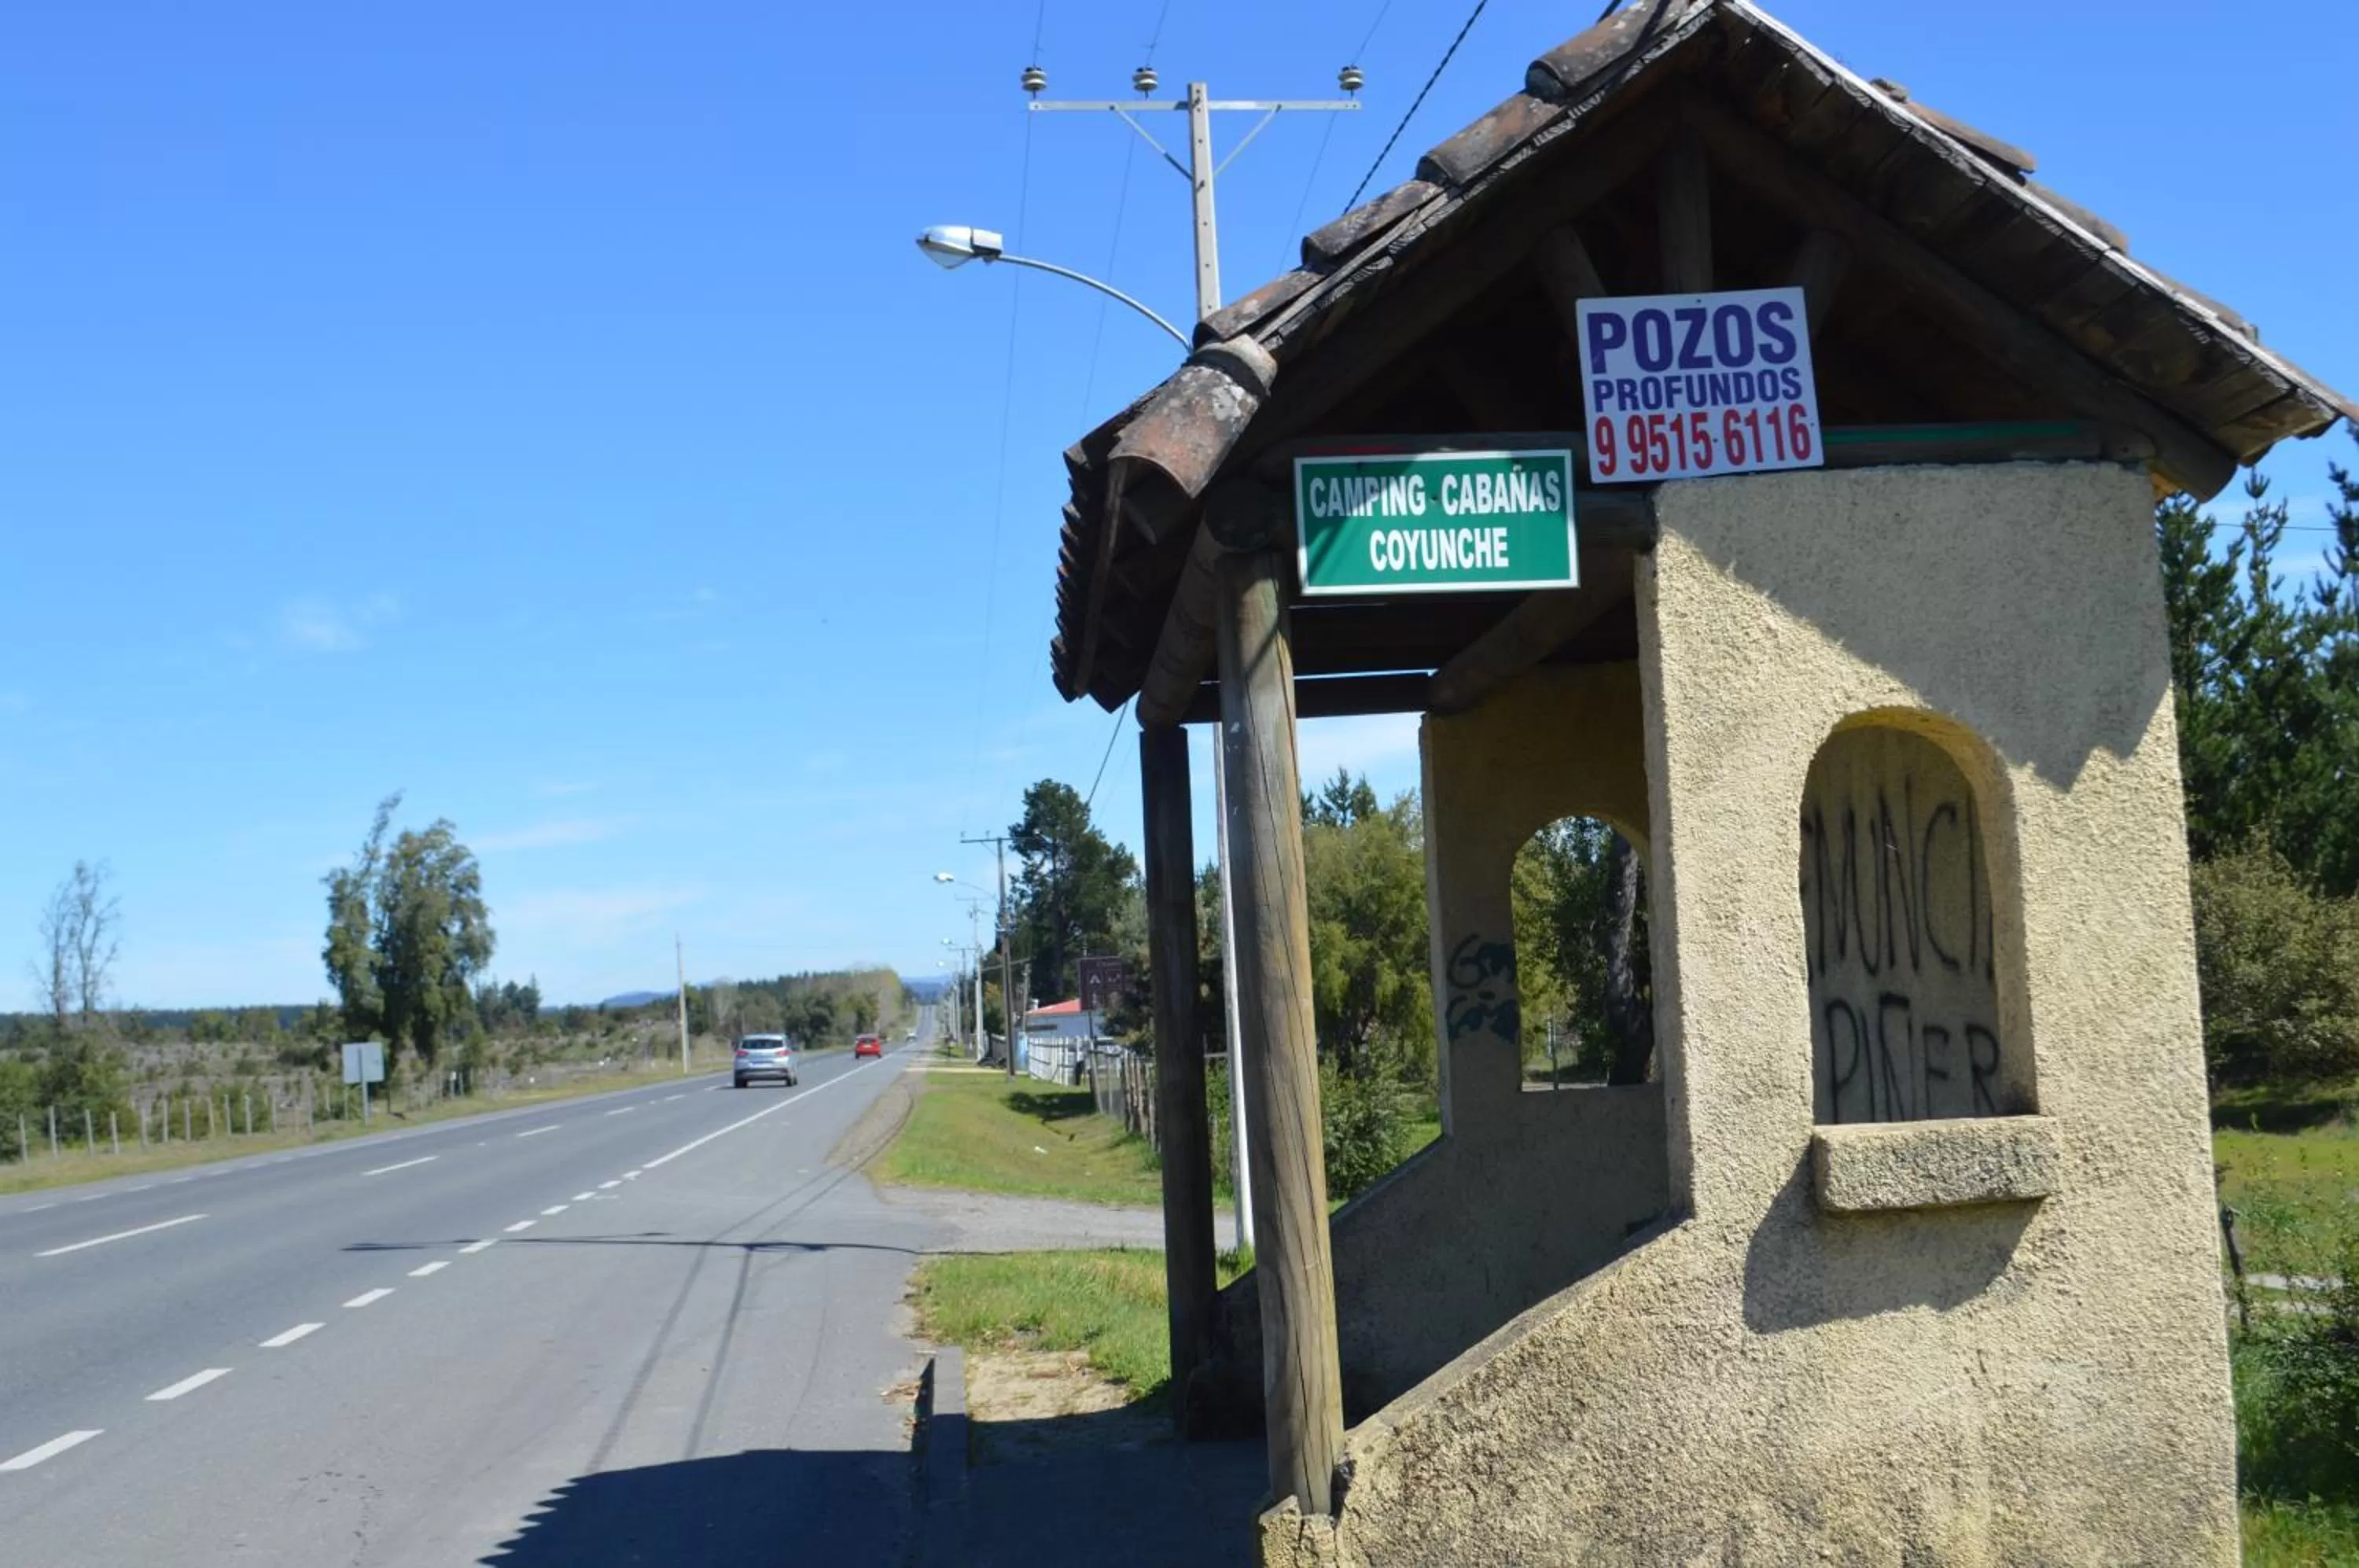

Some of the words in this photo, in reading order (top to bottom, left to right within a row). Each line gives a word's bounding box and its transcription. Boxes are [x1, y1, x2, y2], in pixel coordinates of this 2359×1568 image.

[1586, 301, 1798, 374] POZOS
[1592, 366, 1802, 413] PROFUNDOS
[1595, 415, 1617, 476] 9
[1627, 411, 1713, 474] 9515
[1723, 403, 1811, 466] 6116
[1309, 474, 1426, 517] CAMPING
[1441, 464, 1561, 517] CABAÑAS
[1369, 527, 1509, 572] COYUNCHE
